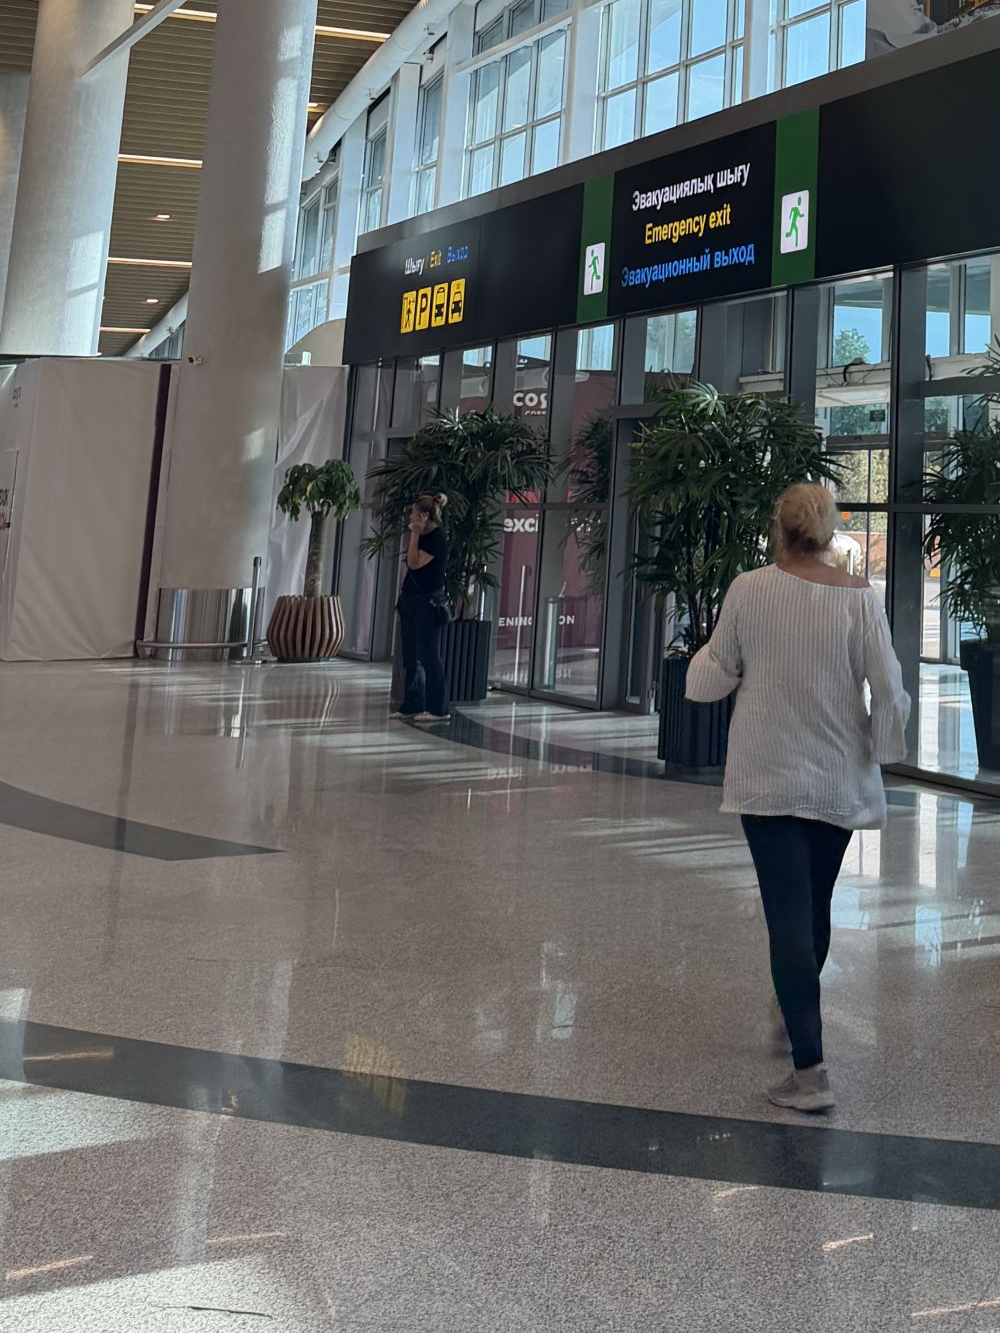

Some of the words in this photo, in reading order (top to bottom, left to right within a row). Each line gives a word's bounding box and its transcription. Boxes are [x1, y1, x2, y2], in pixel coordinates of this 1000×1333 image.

[632, 173, 714, 211] Эвакуациялық
[716, 163, 751, 187] шығу
[644, 214, 706, 244] Emergency
[709, 203, 731, 229] exit
[621, 247, 711, 288] Эвакуационный
[714, 244, 755, 268] выход
